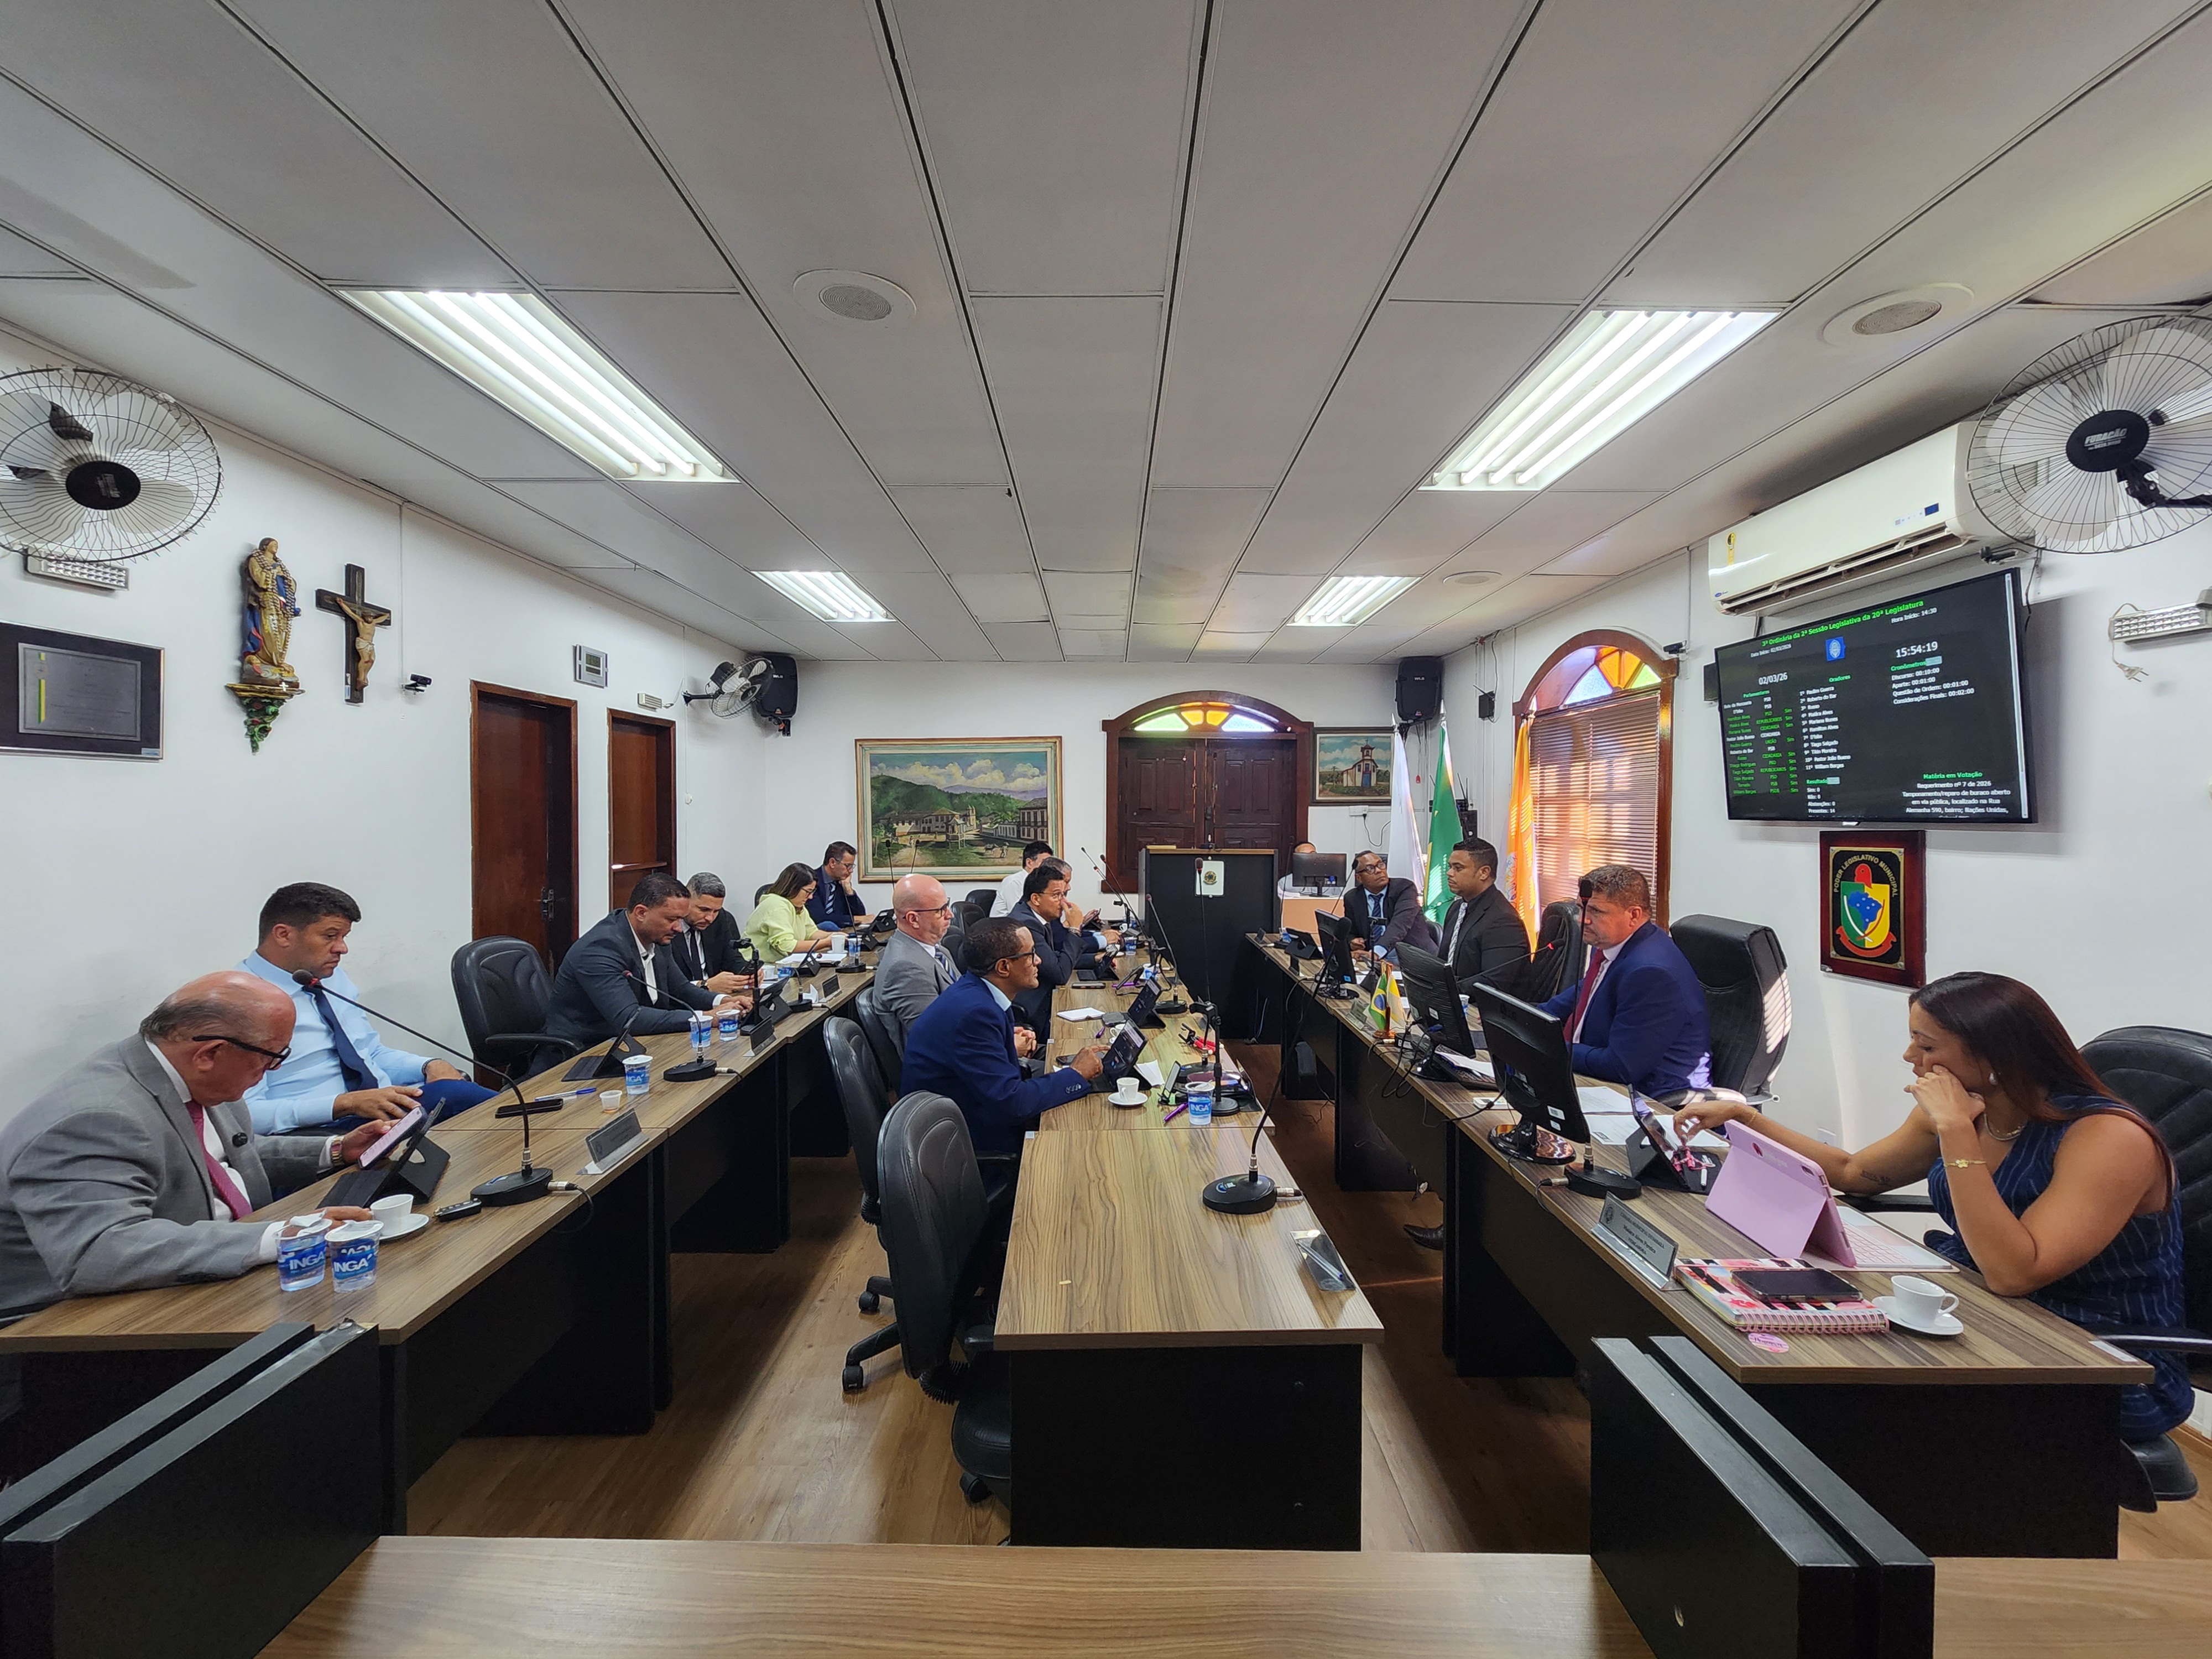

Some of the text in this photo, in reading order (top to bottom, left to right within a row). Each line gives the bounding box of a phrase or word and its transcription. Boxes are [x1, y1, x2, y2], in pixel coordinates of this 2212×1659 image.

[2084, 427, 2127, 445] FURACÃO
[1921, 608, 1937, 616] 14:30
[1769, 634, 1792, 645] Ordinária
[1808, 625, 1828, 635] Sessão
[1829, 617, 1861, 630] Legislativa
[1872, 610, 1884, 619] 20ª
[1885, 600, 1924, 615] Legislatura
[1896, 641, 1938, 658] 15:54:19
[1891, 661, 1927, 671] Cronômetros
[1891, 667, 1940, 681] Discurso: 00:10:00
[1759, 672, 1788, 685] 02/03/26
[1892, 676, 1936, 689] Aparte: 00:01:00
[1893, 688, 1913, 697] Questão
[1943, 680, 1969, 689] 00:01:00
[1893, 687, 1975, 705] Considerações Finais: 00:02:00
[1833, 853, 1899, 898] PODER LEGISLATIVO MUNICIPAL
